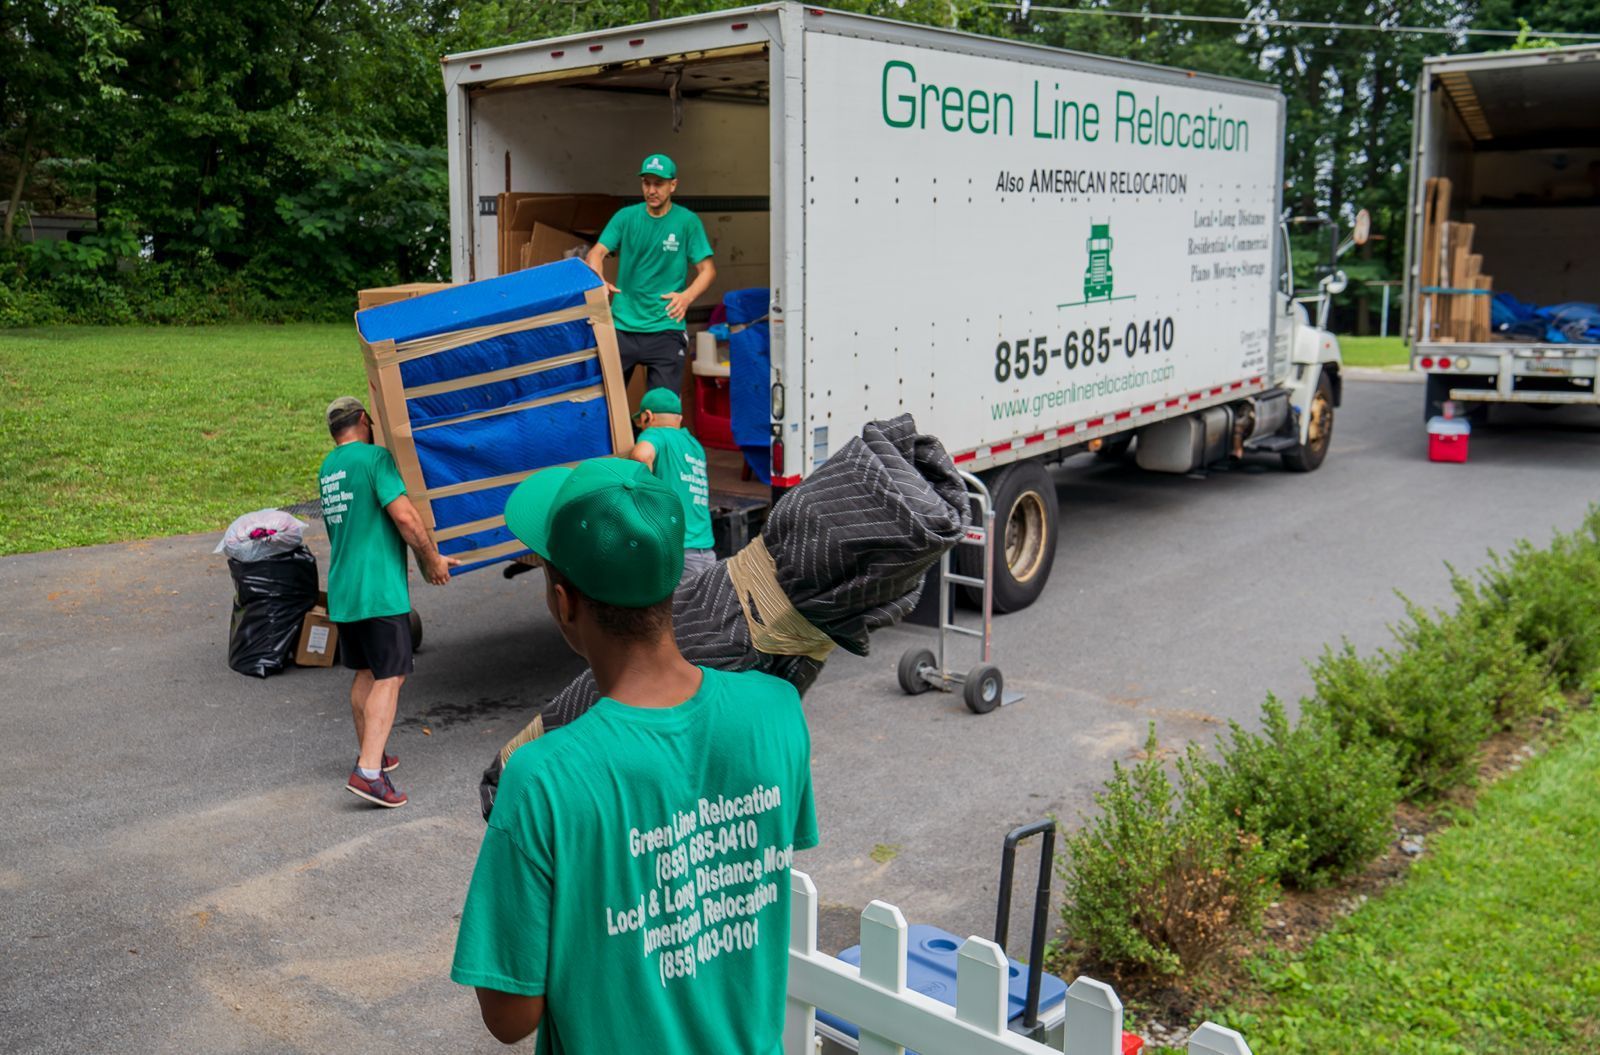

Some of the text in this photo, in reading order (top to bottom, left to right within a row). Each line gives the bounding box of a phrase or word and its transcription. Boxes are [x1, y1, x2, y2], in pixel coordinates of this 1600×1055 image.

[881, 60, 1250, 152] Green Line Relocation
[995, 168, 1188, 195] Also AMERICAN RELOCATION
[994, 316, 1175, 383] 855-685-0410
[990, 364, 1175, 421] www.greenlinerelocation.com
[629, 784, 782, 858] Green Line Relocation
[689, 819, 758, 866] 685-0410
[606, 894, 646, 937] Local
[649, 888, 661, 918] &
[664, 880, 696, 915] Long
[695, 858, 763, 896] Distance
[643, 882, 778, 958] American Relocation
[659, 918, 760, 988] (855) 403-0101
